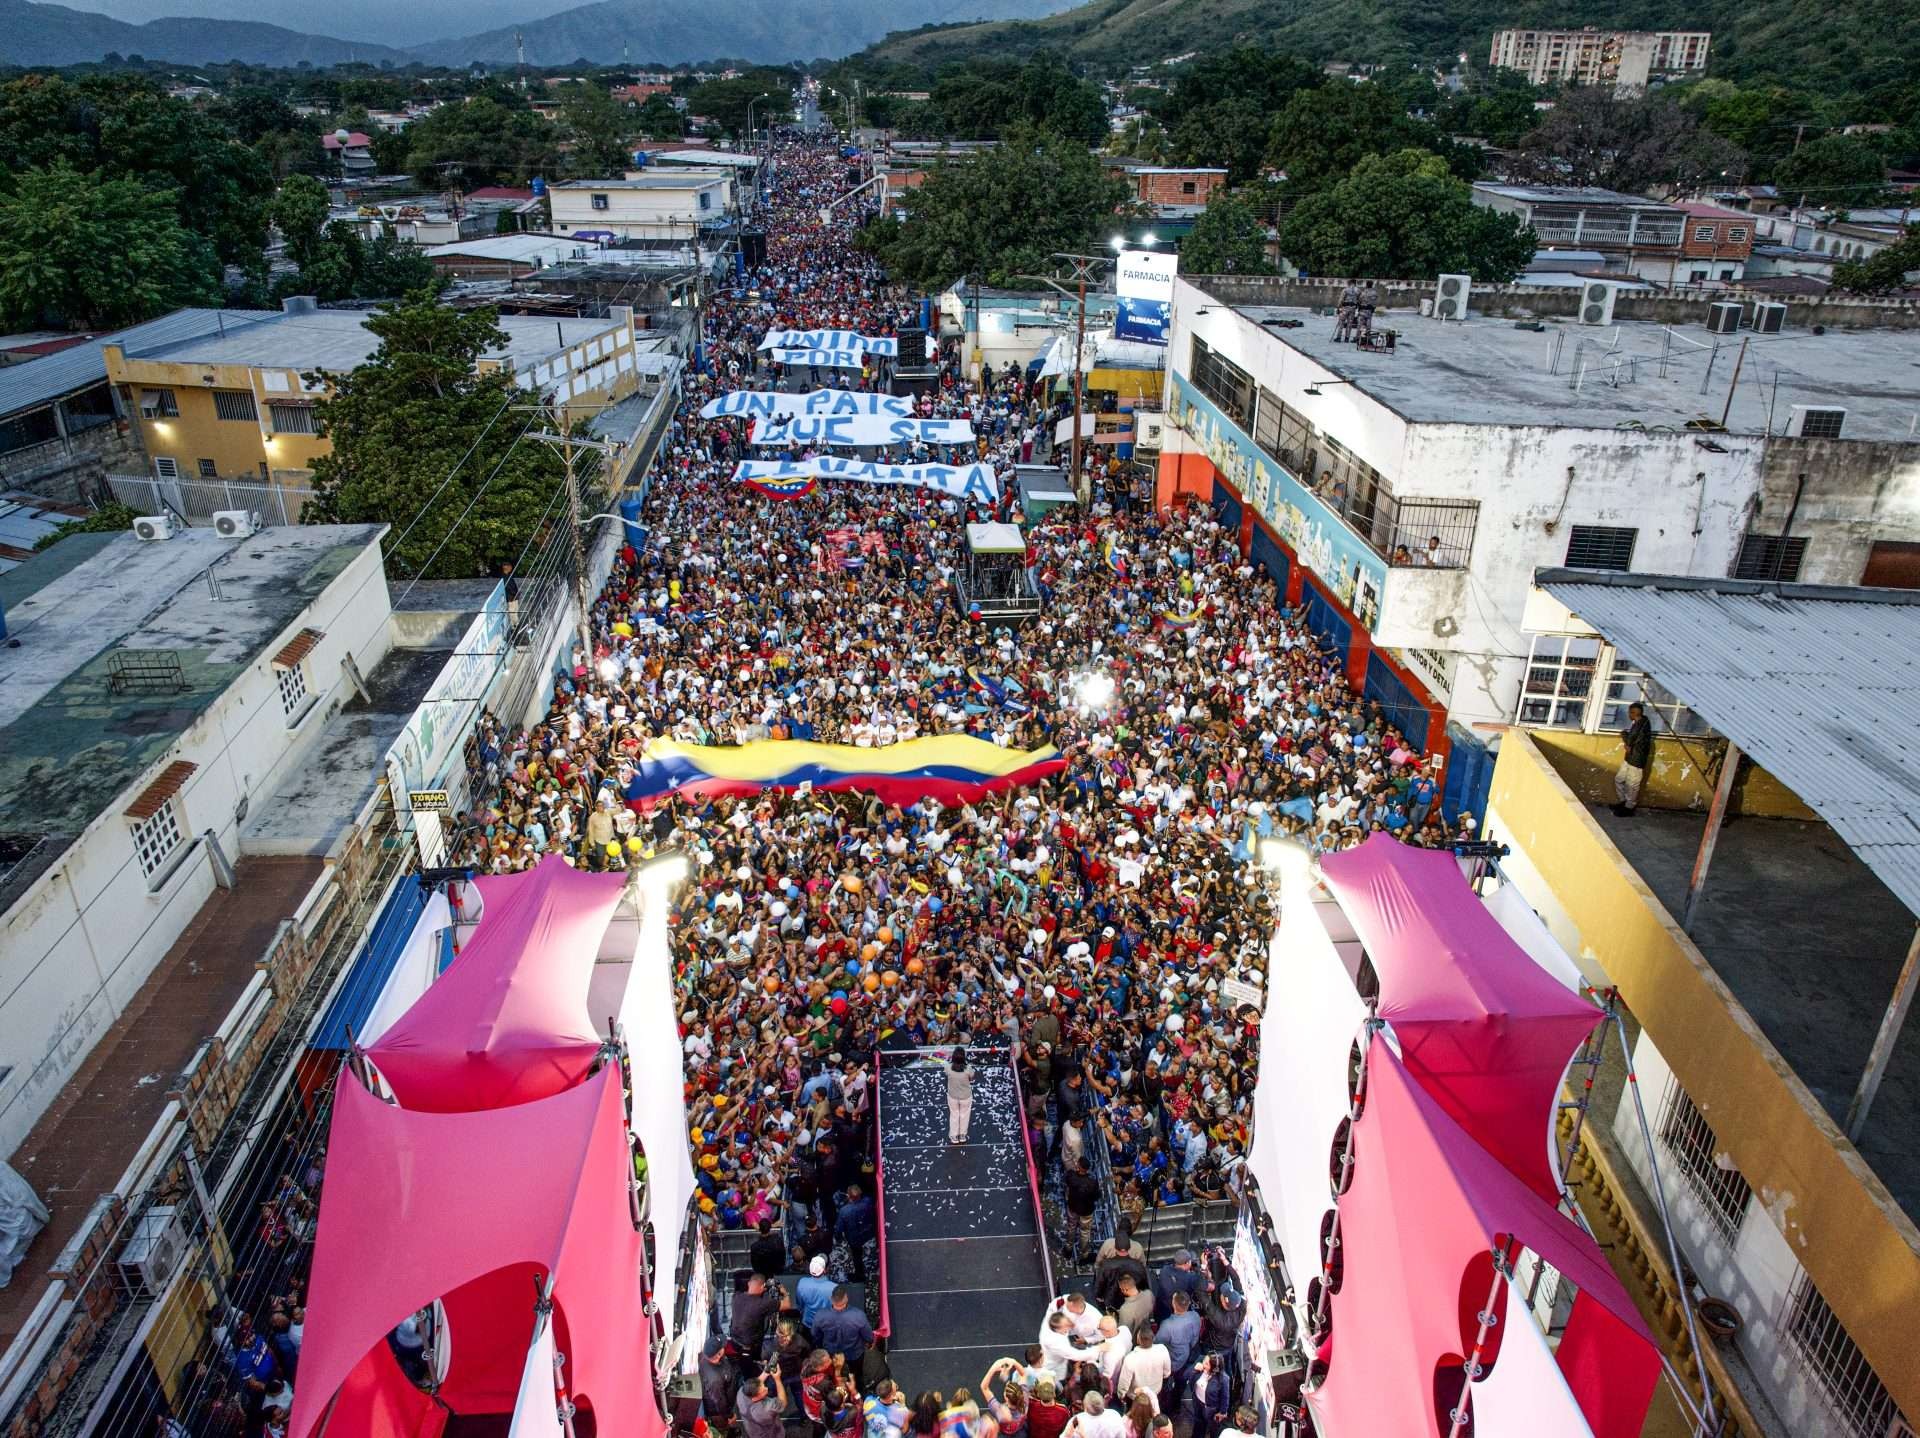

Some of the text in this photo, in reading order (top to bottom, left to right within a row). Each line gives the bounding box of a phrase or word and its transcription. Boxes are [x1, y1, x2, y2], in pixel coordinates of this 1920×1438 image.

[1124, 270, 1170, 283] FARMACIA
[1128, 315, 1161, 326] FARMACIA
[784, 350, 856, 366] POR
[716, 391, 775, 416] UN
[760, 417, 854, 444] QUE
[1408, 648, 1428, 670] MAYOR
[1433, 668, 1450, 693] DETAL
[1438, 656, 1445, 670] AL
